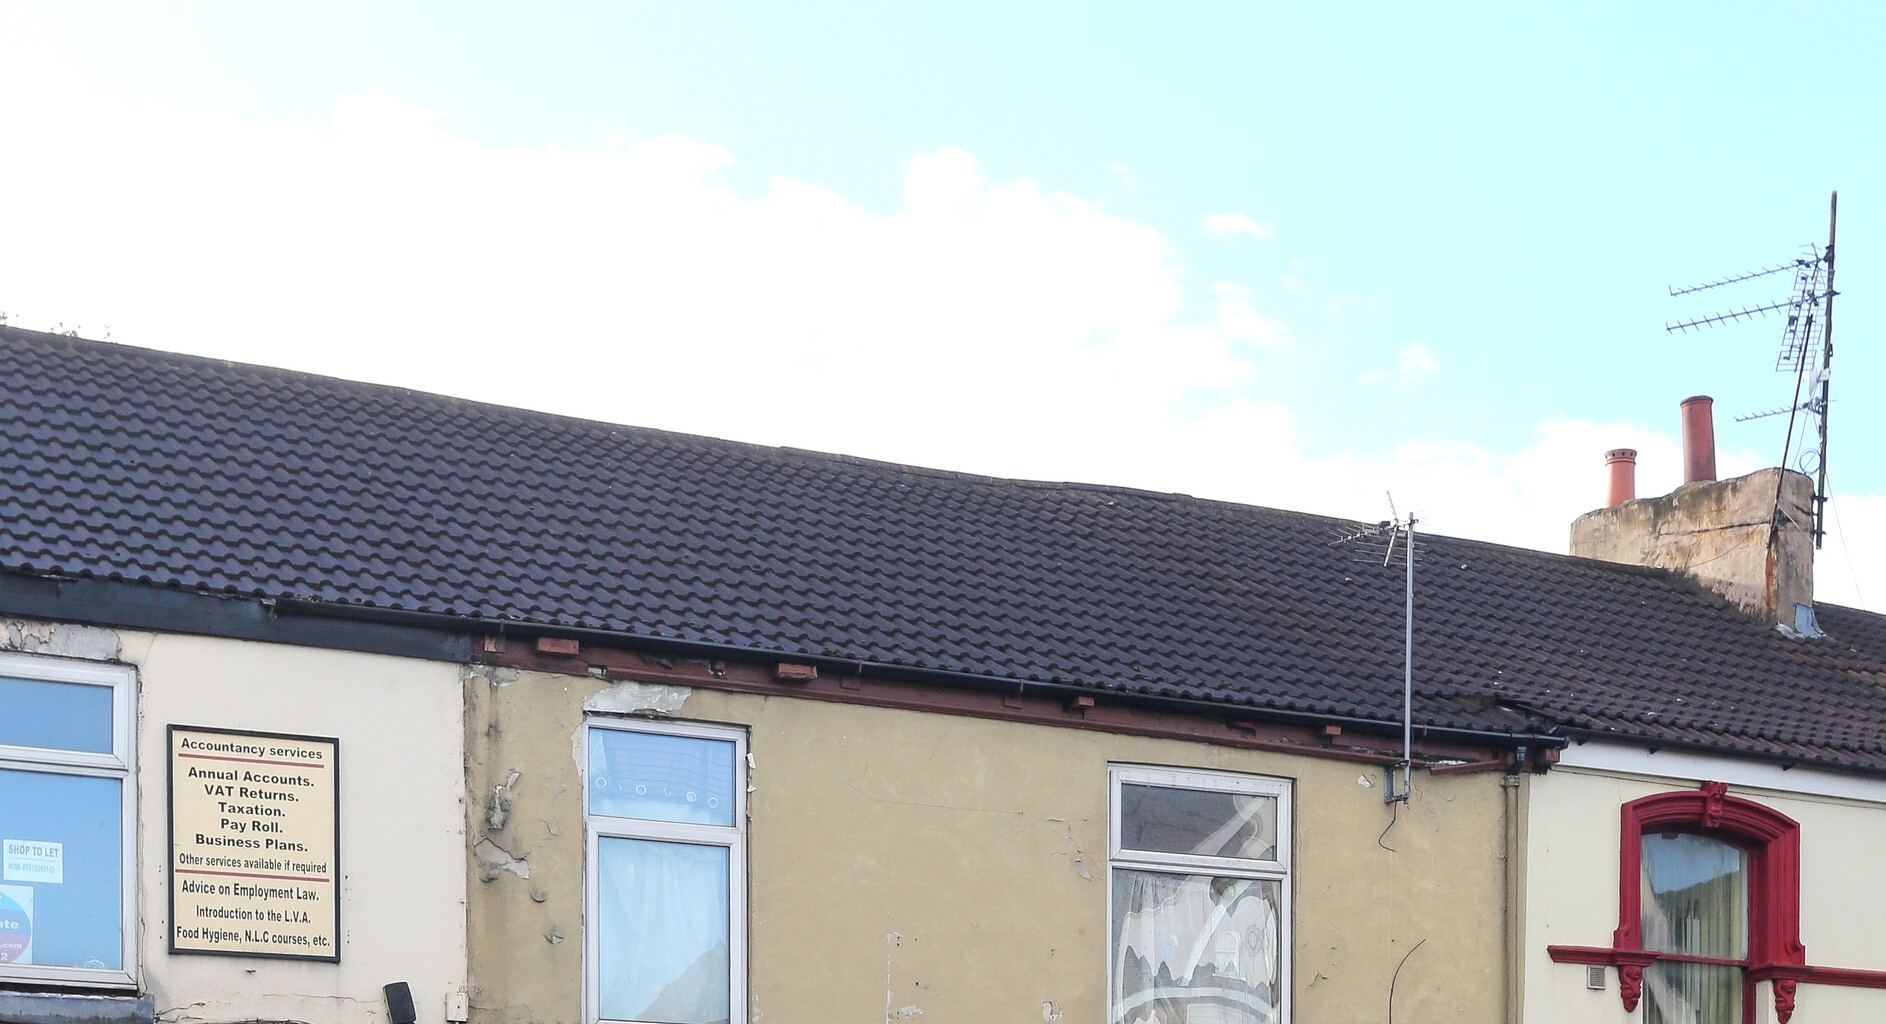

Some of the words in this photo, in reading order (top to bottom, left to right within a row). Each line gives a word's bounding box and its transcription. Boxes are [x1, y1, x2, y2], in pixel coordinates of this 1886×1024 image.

[181, 738, 265, 757] Accountancy
[270, 747, 323, 759] services
[188, 767, 238, 781] Annual
[243, 771, 314, 787] Accounts.
[205, 784, 234, 796] VAT
[239, 787, 299, 802] Returns.
[218, 802, 286, 817] Taxation.
[221, 818, 247, 833] Pay
[252, 820, 283, 833] Roll.
[9, 844, 30, 855] SHOP
[32, 846, 43, 856] TO
[45, 847, 59, 858] LET
[195, 834, 260, 849] Business
[265, 838, 308, 852] Plans.
[179, 853, 203, 865] Other
[206, 856, 241, 868] services
[244, 858, 282, 870] available
[284, 860, 290, 871] if
[292, 862, 326, 874] required
[182, 880, 215, 895] Advice
[219, 884, 230, 896] on
[234, 883, 293, 901] Employment
[296, 887, 319, 901] Law.
[196, 905, 251, 920] Introduction
[255, 909, 264, 921] to
[267, 909, 282, 922] the
[285, 910, 311, 923] L.V.A.
[177, 926, 199, 939] Food
[202, 928, 242, 944] Hygiene,
[245, 930, 269, 943] N.L.C
[272, 933, 310, 948] courses,
[313, 935, 330, 947] etc.
